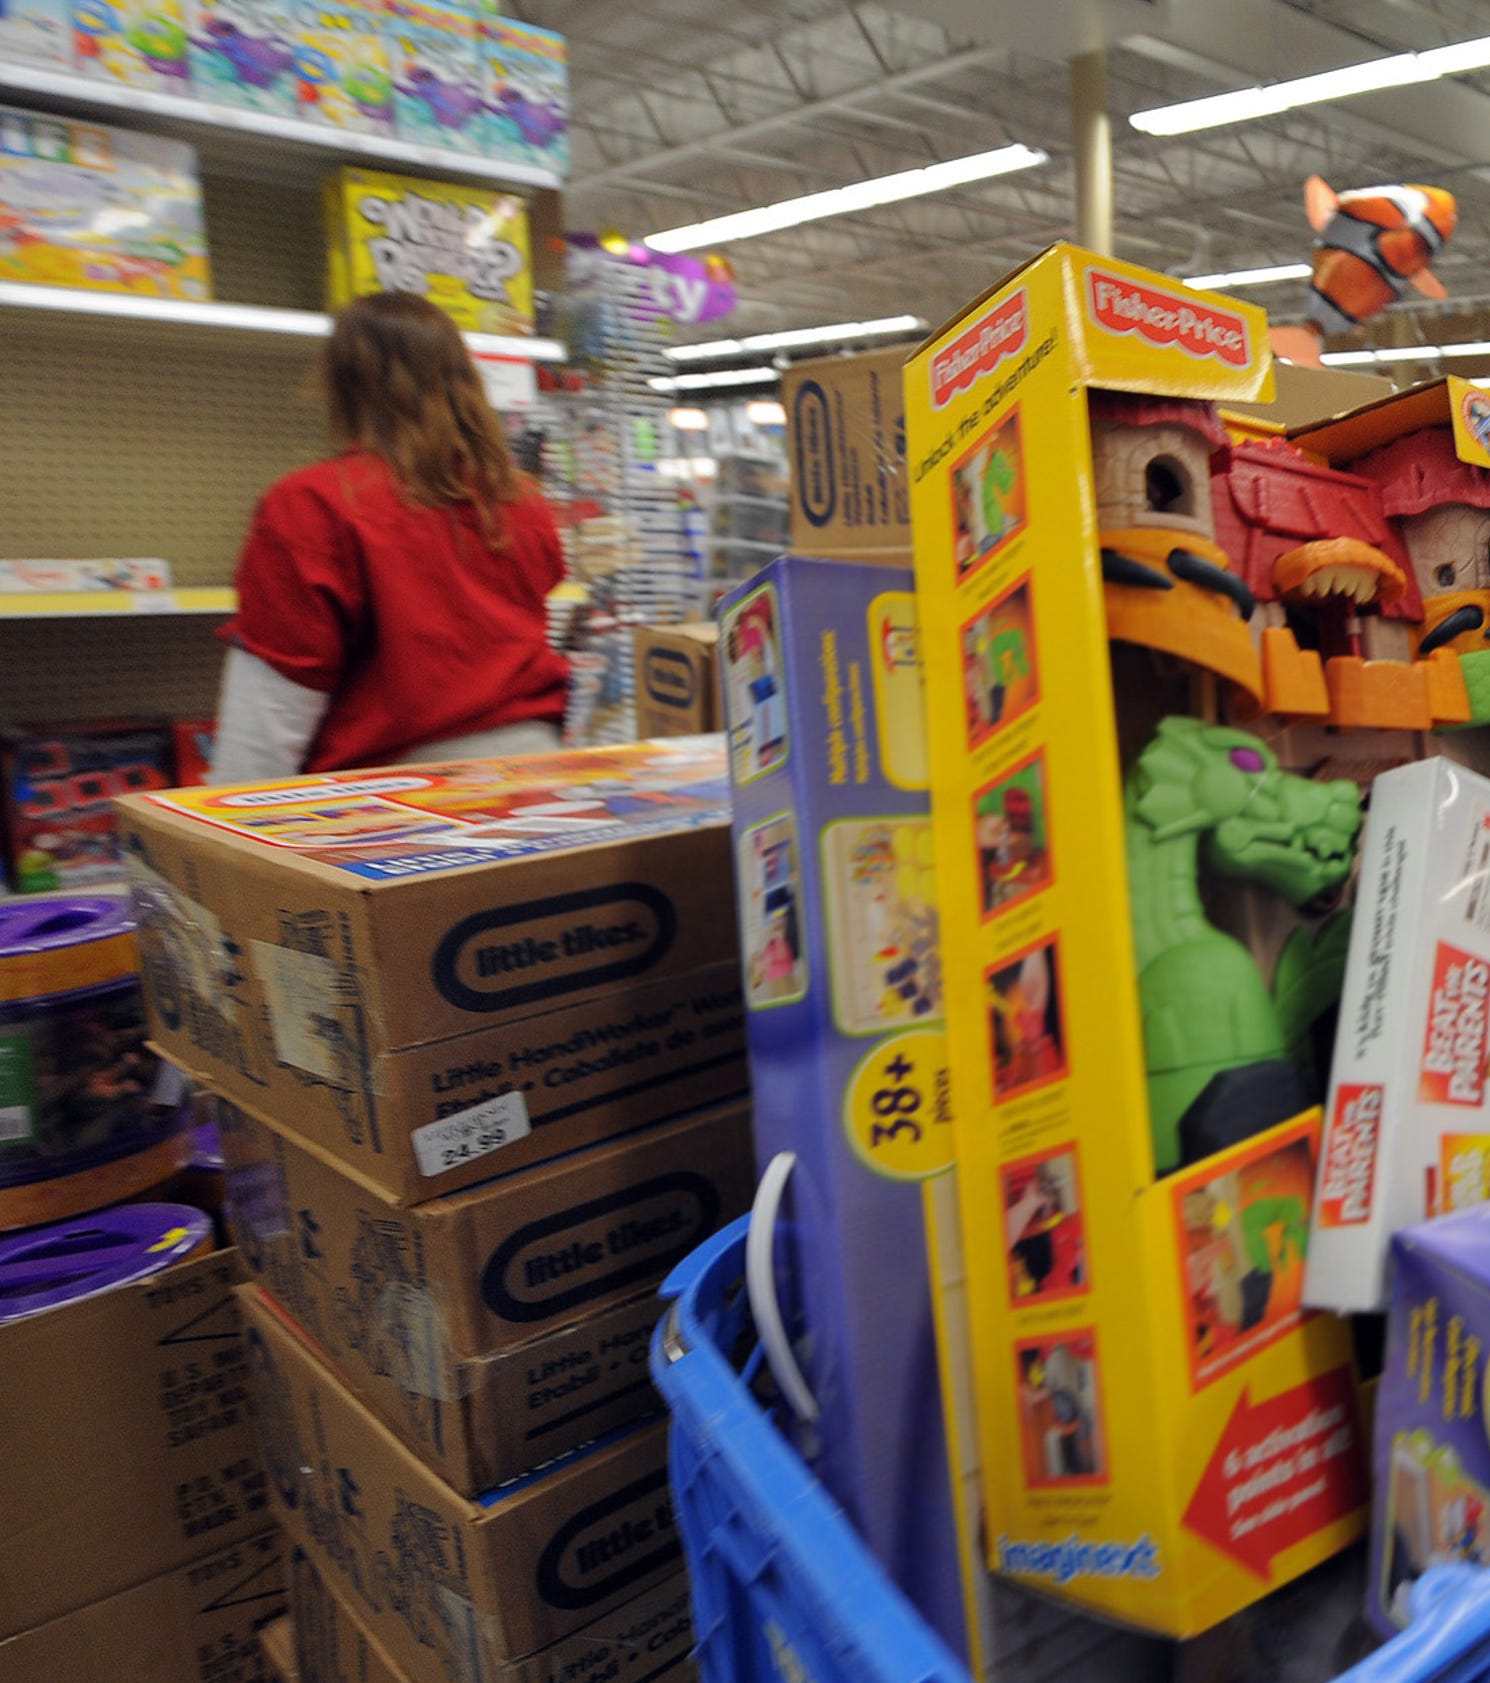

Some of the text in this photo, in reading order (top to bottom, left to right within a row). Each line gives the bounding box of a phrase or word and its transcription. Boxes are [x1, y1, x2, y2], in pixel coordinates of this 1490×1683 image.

[935, 311, 1024, 390] Fisher-Price
[1096, 282, 1244, 351] Fisher-Price
[474, 917, 649, 979] little tikes
[1426, 987, 1456, 1074] BEAT
[1449, 958, 1490, 1102] PARENTS
[431, 1060, 502, 1093] Little
[871, 1052, 923, 1149] 38+
[1324, 1124, 1352, 1199] BEAT
[1340, 1088, 1381, 1222] PARENTS
[525, 1210, 694, 1289] little tikes
[527, 1350, 593, 1386] Little
[576, 1518, 655, 1575] little
[999, 1532, 1161, 1585] imaginext
